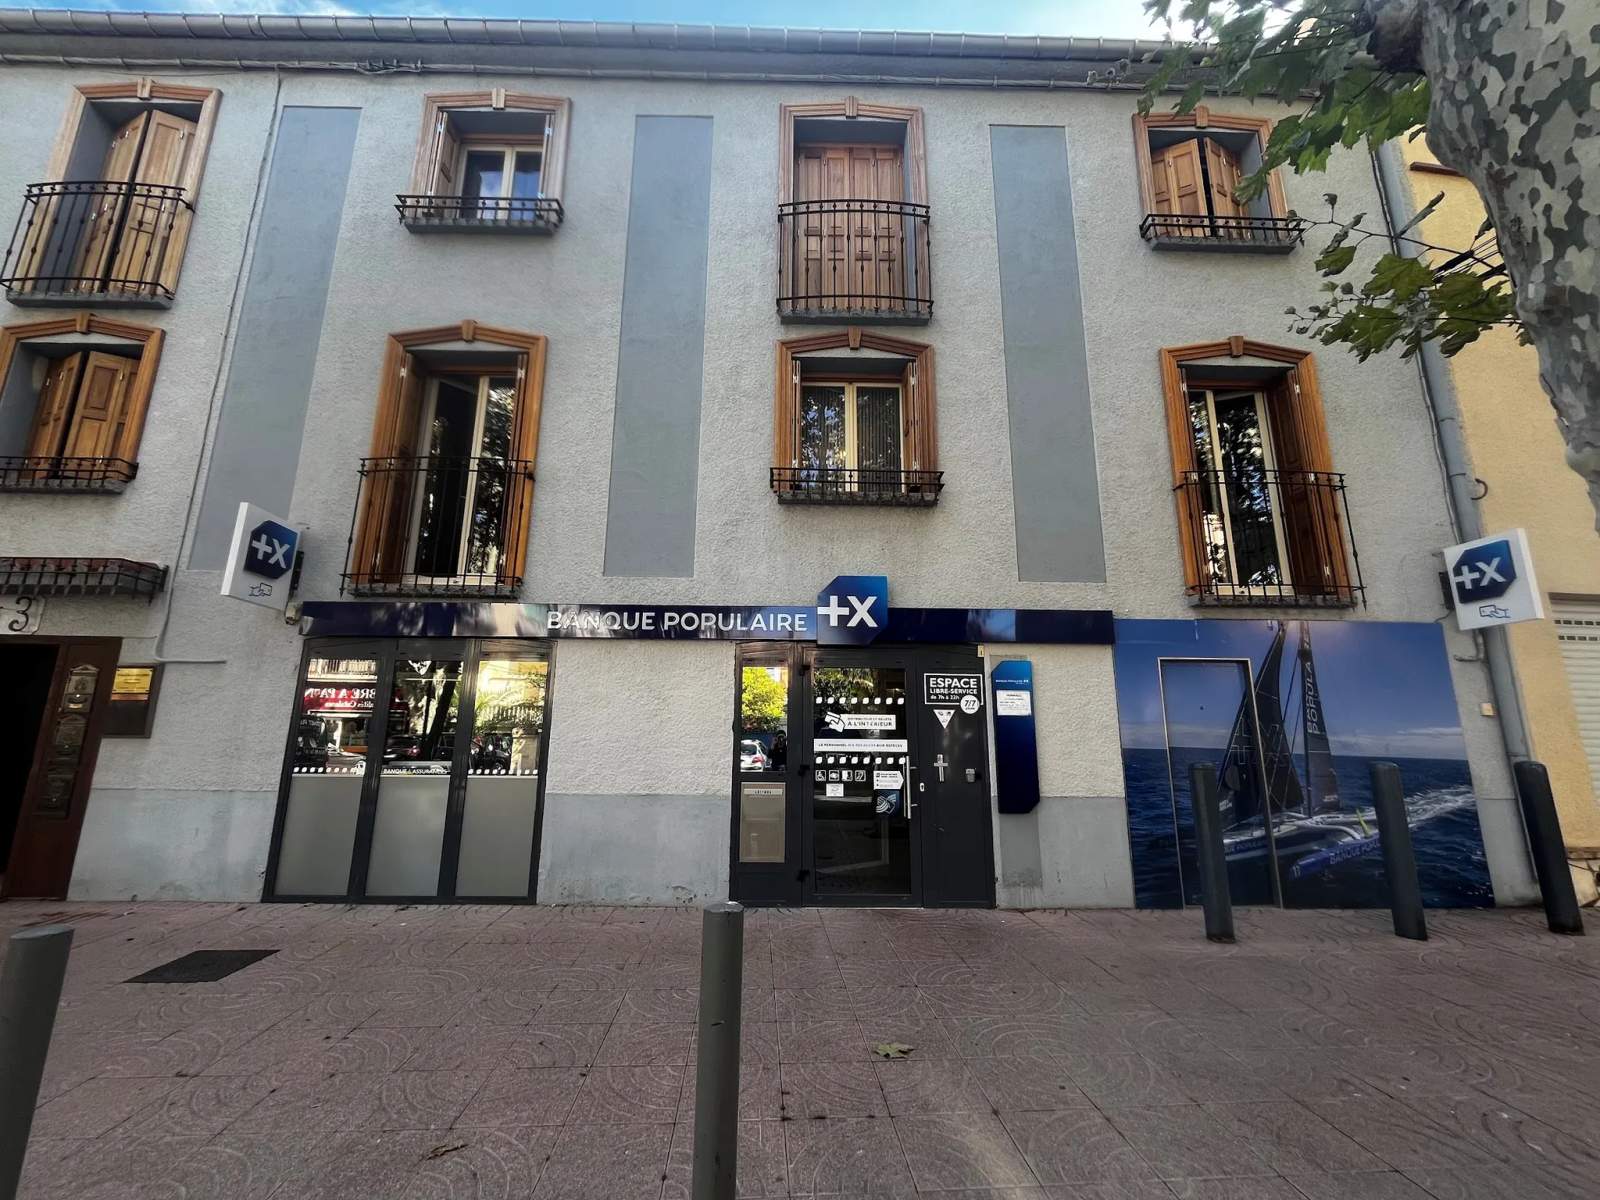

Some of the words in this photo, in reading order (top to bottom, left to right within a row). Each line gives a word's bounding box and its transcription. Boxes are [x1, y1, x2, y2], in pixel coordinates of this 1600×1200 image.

[547, 610, 655, 632] BANQUE
[663, 611, 809, 633] POPULAIRE
[929, 677, 979, 689] ESPACE
[964, 699, 977, 708] 7/7
